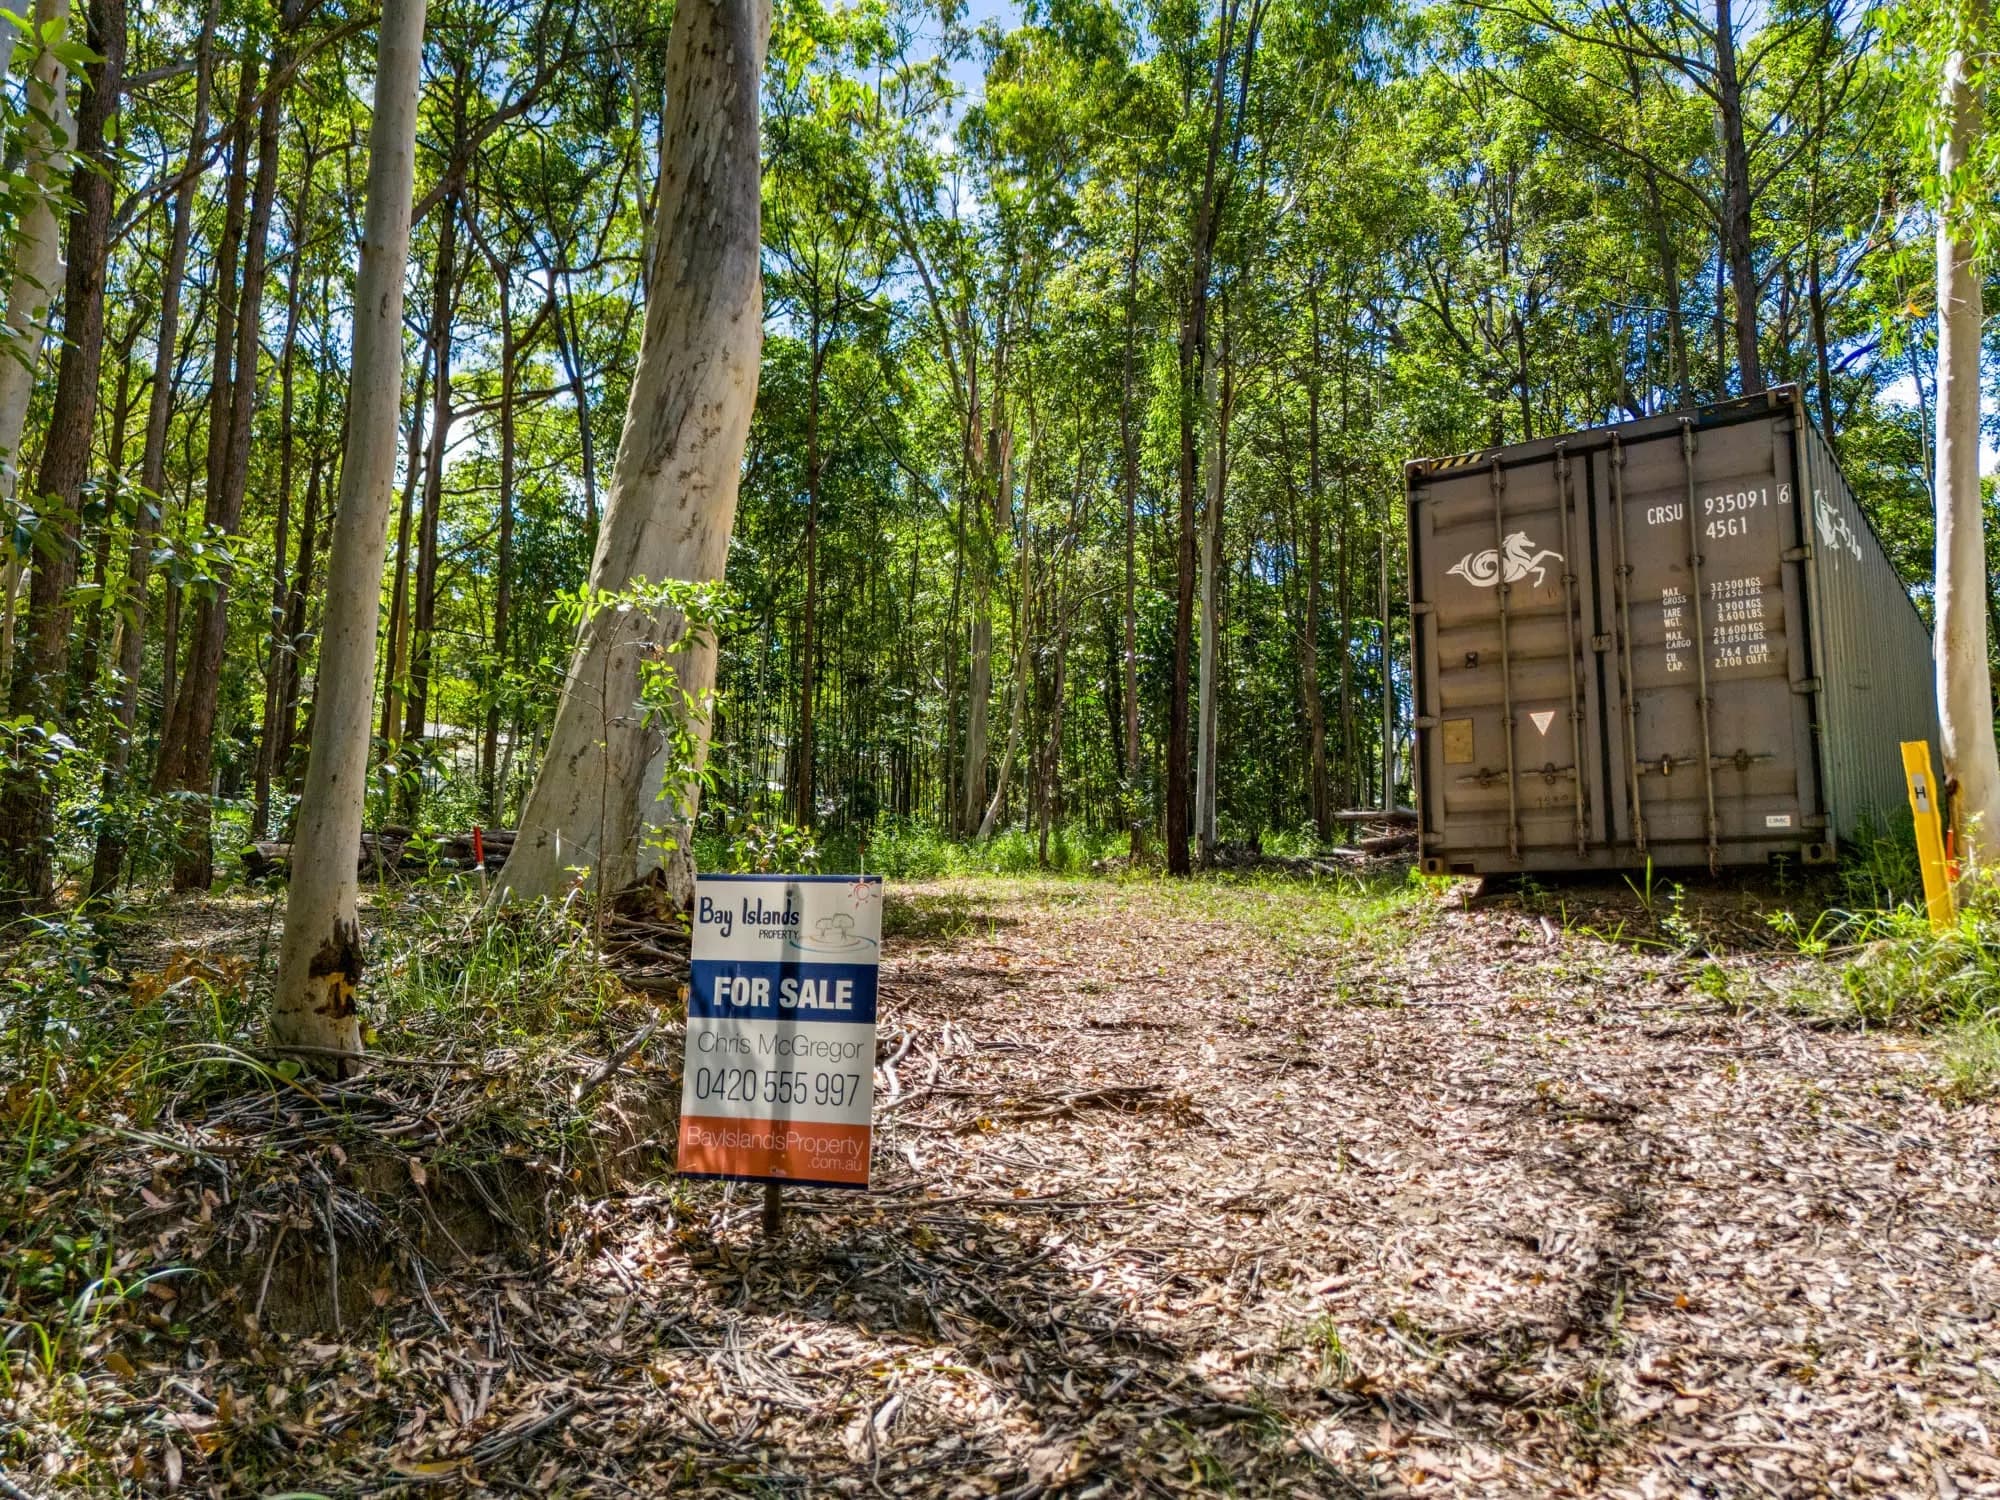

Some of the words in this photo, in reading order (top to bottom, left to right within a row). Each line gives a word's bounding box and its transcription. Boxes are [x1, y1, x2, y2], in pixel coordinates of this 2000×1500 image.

[1647, 503, 1683, 525] CRSU
[1704, 488, 1768, 515] 935091
[1778, 484, 1790, 503] 6
[1706, 516, 1747, 539] 45G1
[1662, 595, 1687, 605] GROSS
[1663, 608, 1681, 618] TARE
[1666, 640, 1691, 649] CARGO
[1720, 646, 1741, 657] 76.4
[1667, 661, 1686, 672] CAP.
[1715, 656, 1742, 668] 2.700
[1914, 785, 1927, 799] H
[699, 896, 733, 938] Bay
[742, 896, 800, 926] Islands
[758, 929, 799, 940] PROPERTY
[713, 976, 770, 1008] FOR
[779, 977, 853, 1010] SALE
[697, 1031, 751, 1055] Chris
[758, 1033, 864, 1063] McGregor
[696, 1067, 757, 1101] 0420
[763, 1070, 808, 1104] 555
[814, 1072, 860, 1107] 997
[687, 1126, 864, 1159] BayIslandsProperty
[807, 1156, 863, 1172] .com.au
